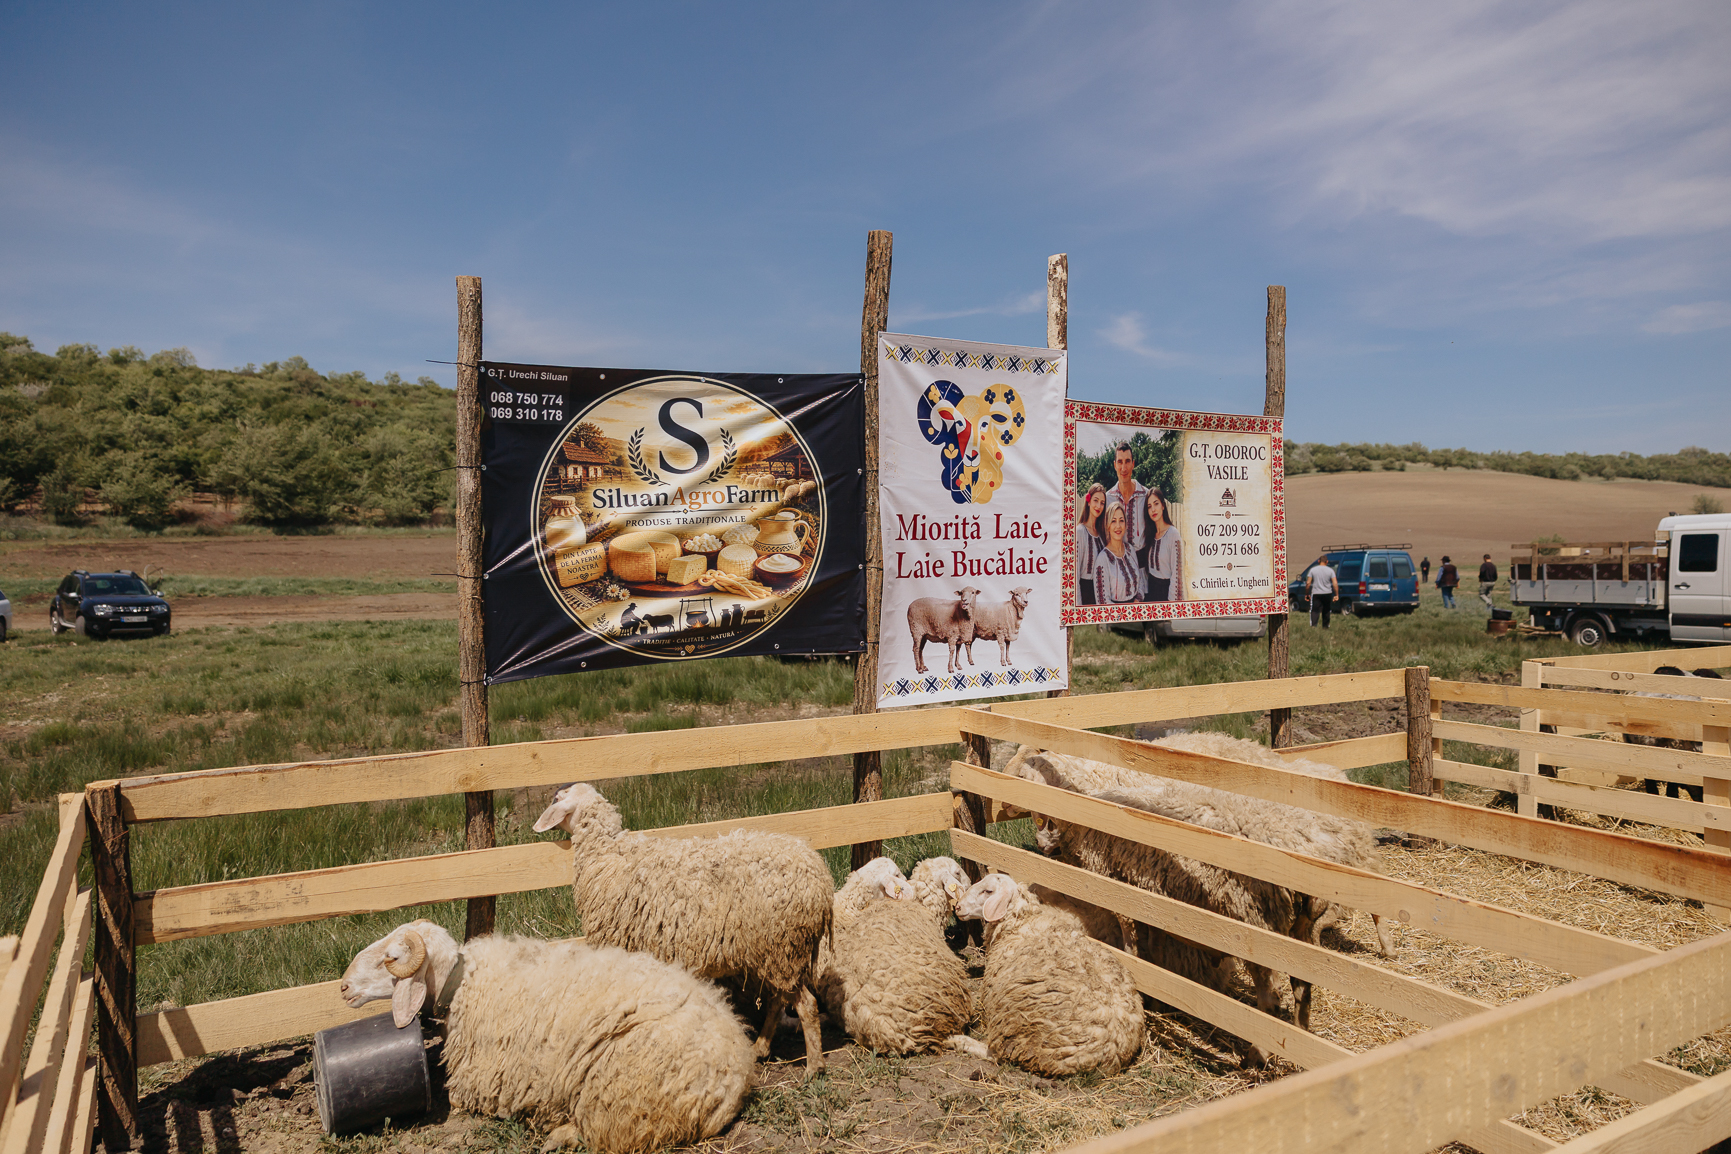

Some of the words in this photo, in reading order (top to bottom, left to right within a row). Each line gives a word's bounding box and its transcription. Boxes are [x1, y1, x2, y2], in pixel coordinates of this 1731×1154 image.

[509, 369, 539, 380] Urechi
[540, 371, 568, 382] Siluan
[490, 391, 513, 404] 068
[516, 392, 538, 405] 750
[541, 394, 563, 406] 774
[491, 407, 513, 419] 069
[515, 408, 538, 420] 310
[541, 409, 563, 421] 178
[657, 397, 710, 475] S
[1189, 442, 1212, 462] G.Ț.
[1215, 444, 1267, 461] OBOROC
[1206, 464, 1249, 481] VASILE
[592, 484, 780, 510] SiluanAgroFarm
[625, 517, 672, 528] PRODUSE
[676, 515, 747, 526] TRADIȚIONALE
[895, 512, 982, 549] Mioriță
[993, 512, 1049, 545] Laie,
[1197, 524, 1217, 537] 067
[1218, 524, 1238, 537] 209
[1240, 524, 1260, 537] 902
[562, 551, 576, 560] DIN
[576, 547, 598, 558] LAPTE
[1199, 542, 1219, 556] 069
[1221, 542, 1238, 556] 751
[1240, 542, 1260, 555] 686
[560, 560, 570, 568] DE
[570, 558, 580, 566] LA
[580, 554, 603, 564] FERMA
[895, 551, 944, 580] Laie
[951, 547, 1048, 578] Bucălaie
[1200, 577, 1229, 589] Chirilei
[1230, 580, 1236, 588] r.
[1237, 576, 1270, 589] Ungheni
[676, 635, 705, 644] CALITATE
